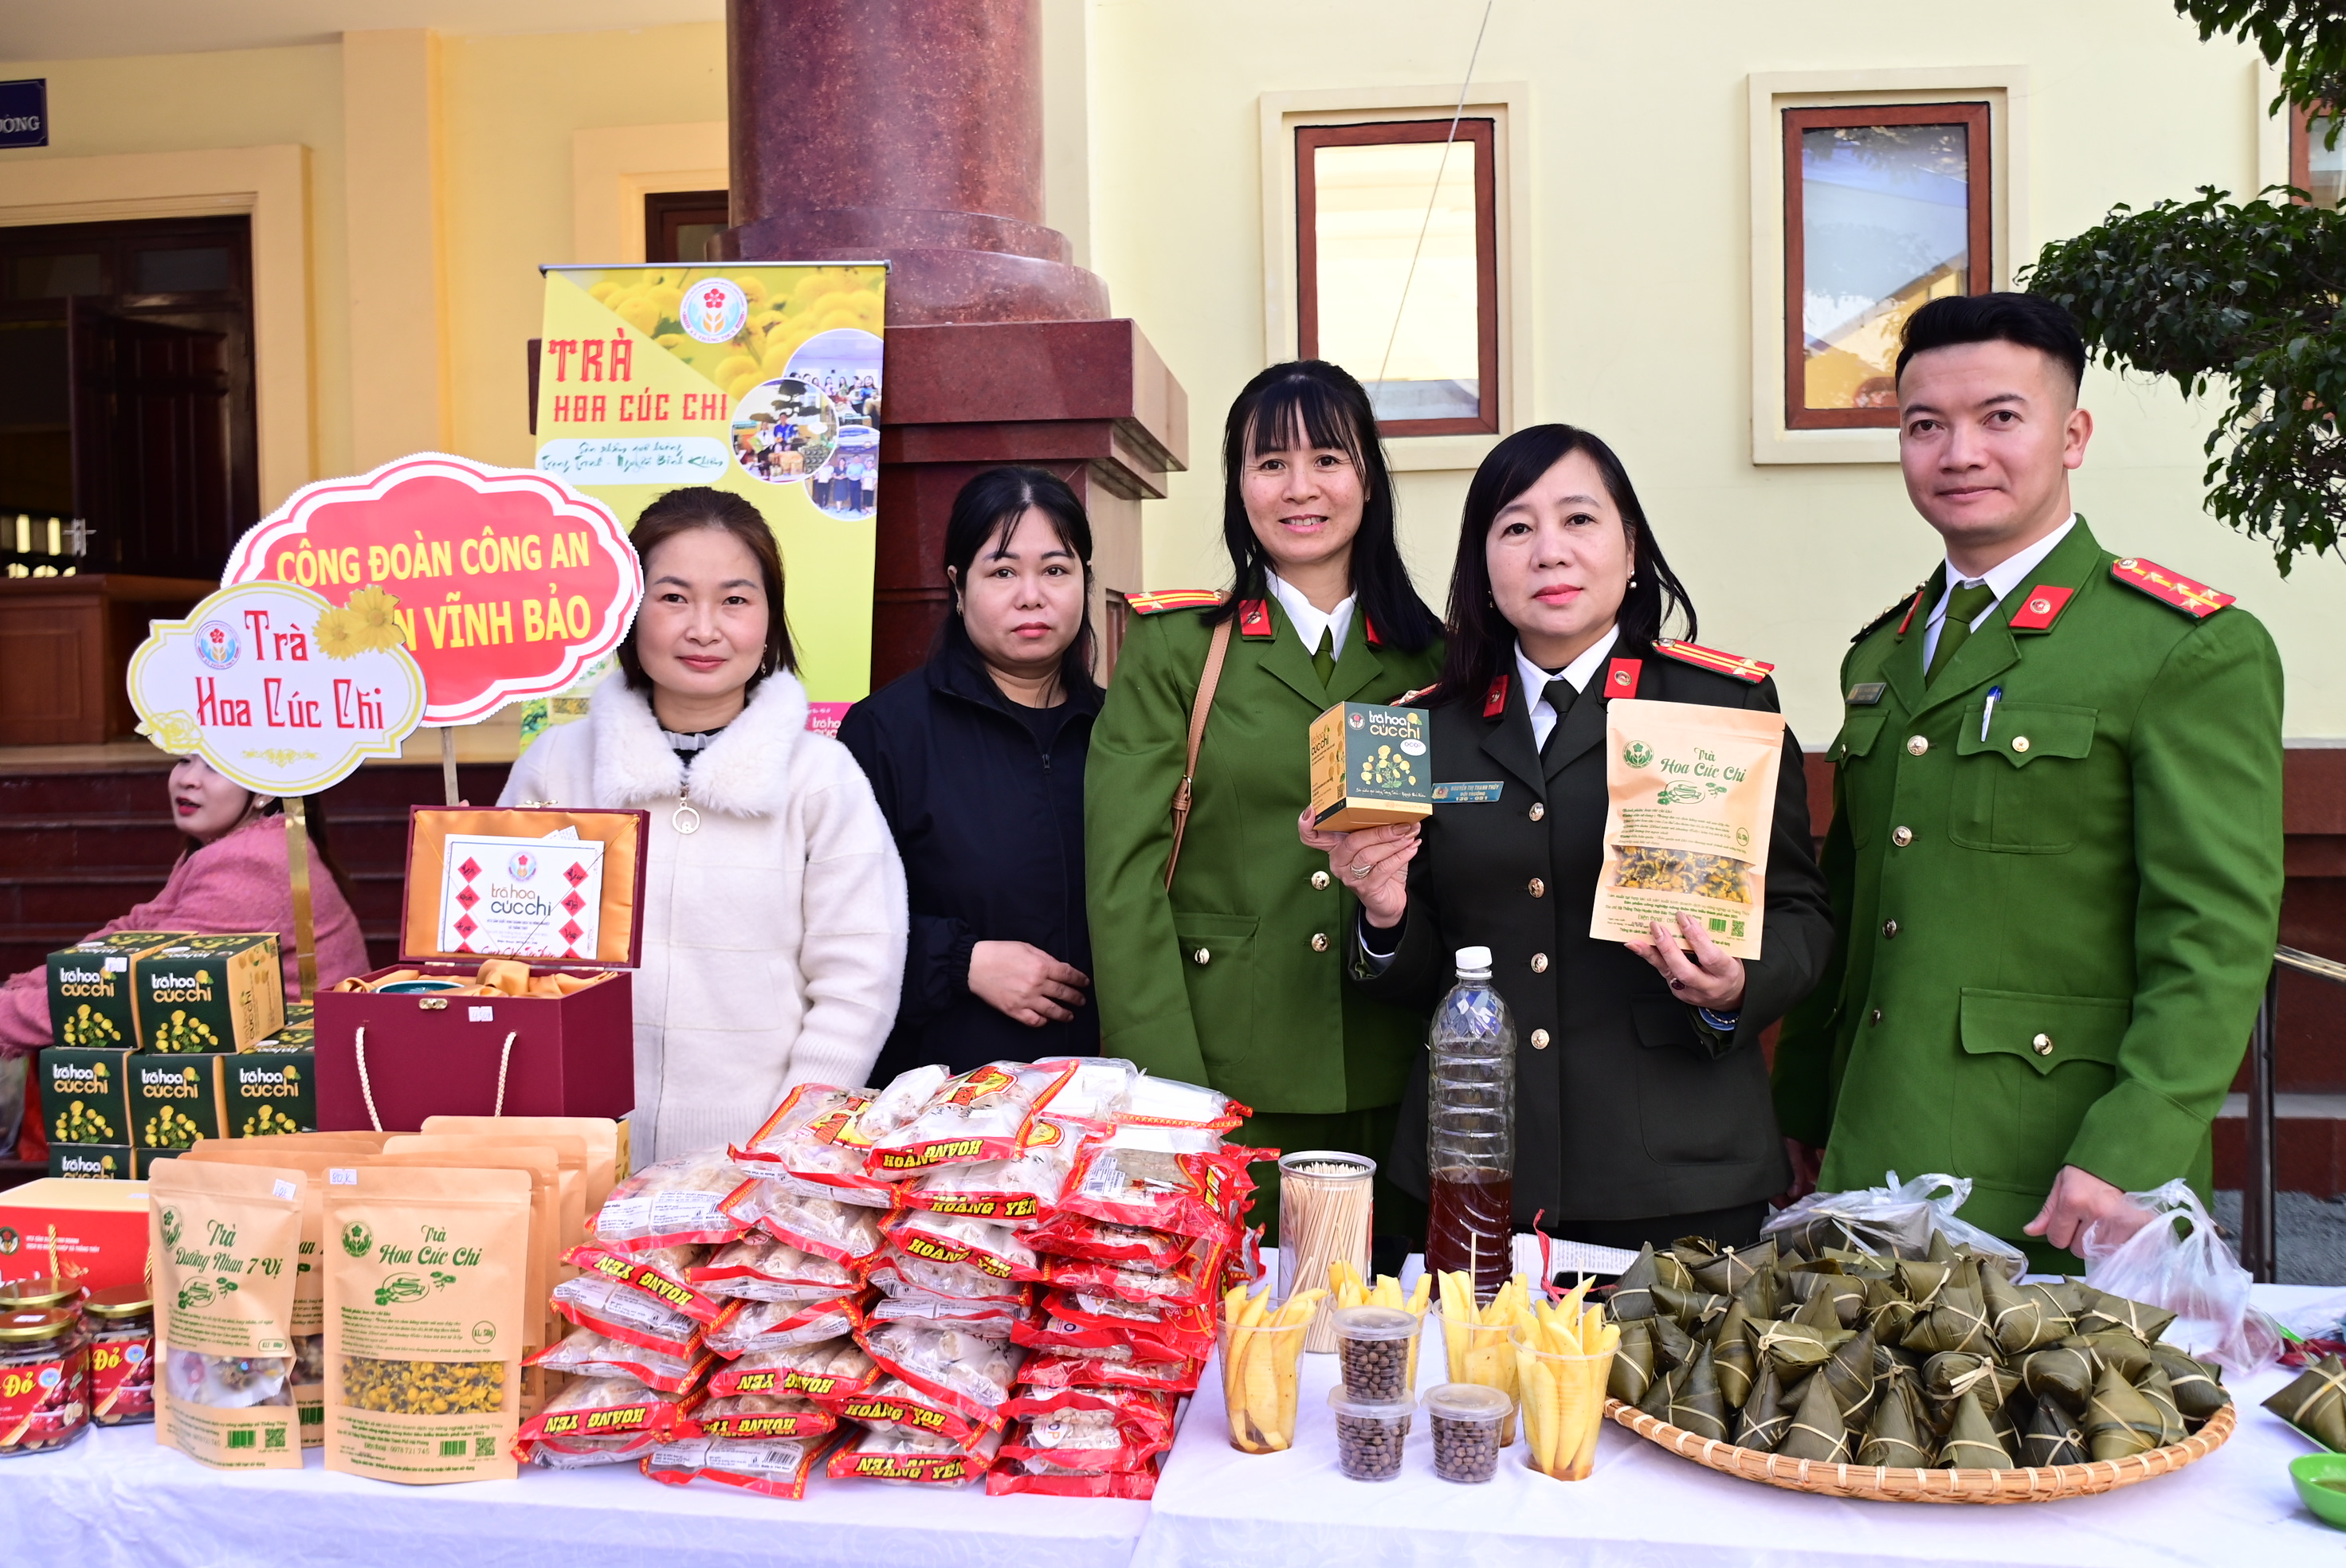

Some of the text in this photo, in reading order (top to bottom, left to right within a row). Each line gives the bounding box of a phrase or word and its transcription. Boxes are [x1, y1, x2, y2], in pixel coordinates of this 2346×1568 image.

[547, 327, 634, 382] TRÀ
[554, 386, 728, 422] HOA CÚC CHI
[277, 526, 590, 587] CÔNG ĐOÀN CÔNG AN
[424, 590, 512, 650] VĨNH
[523, 582, 590, 641] BẢO
[244, 610, 309, 661] Trà
[195, 676, 384, 729] Hoa Cúc Chi
[1694, 747, 1716, 762] Trà
[1661, 758, 1747, 782] Hoa Cúc Chi
[207, 1219, 237, 1248] Trà
[421, 1225, 446, 1243] Trà
[213, 1252, 244, 1273] Nhan
[247, 1257, 259, 1275] 7
[261, 1257, 283, 1279] Vị
[379, 1245, 483, 1266] Hoa Cúc Chi
[92, 1345, 123, 1372] Đỏ
[3, 1370, 37, 1398] Đỏ
